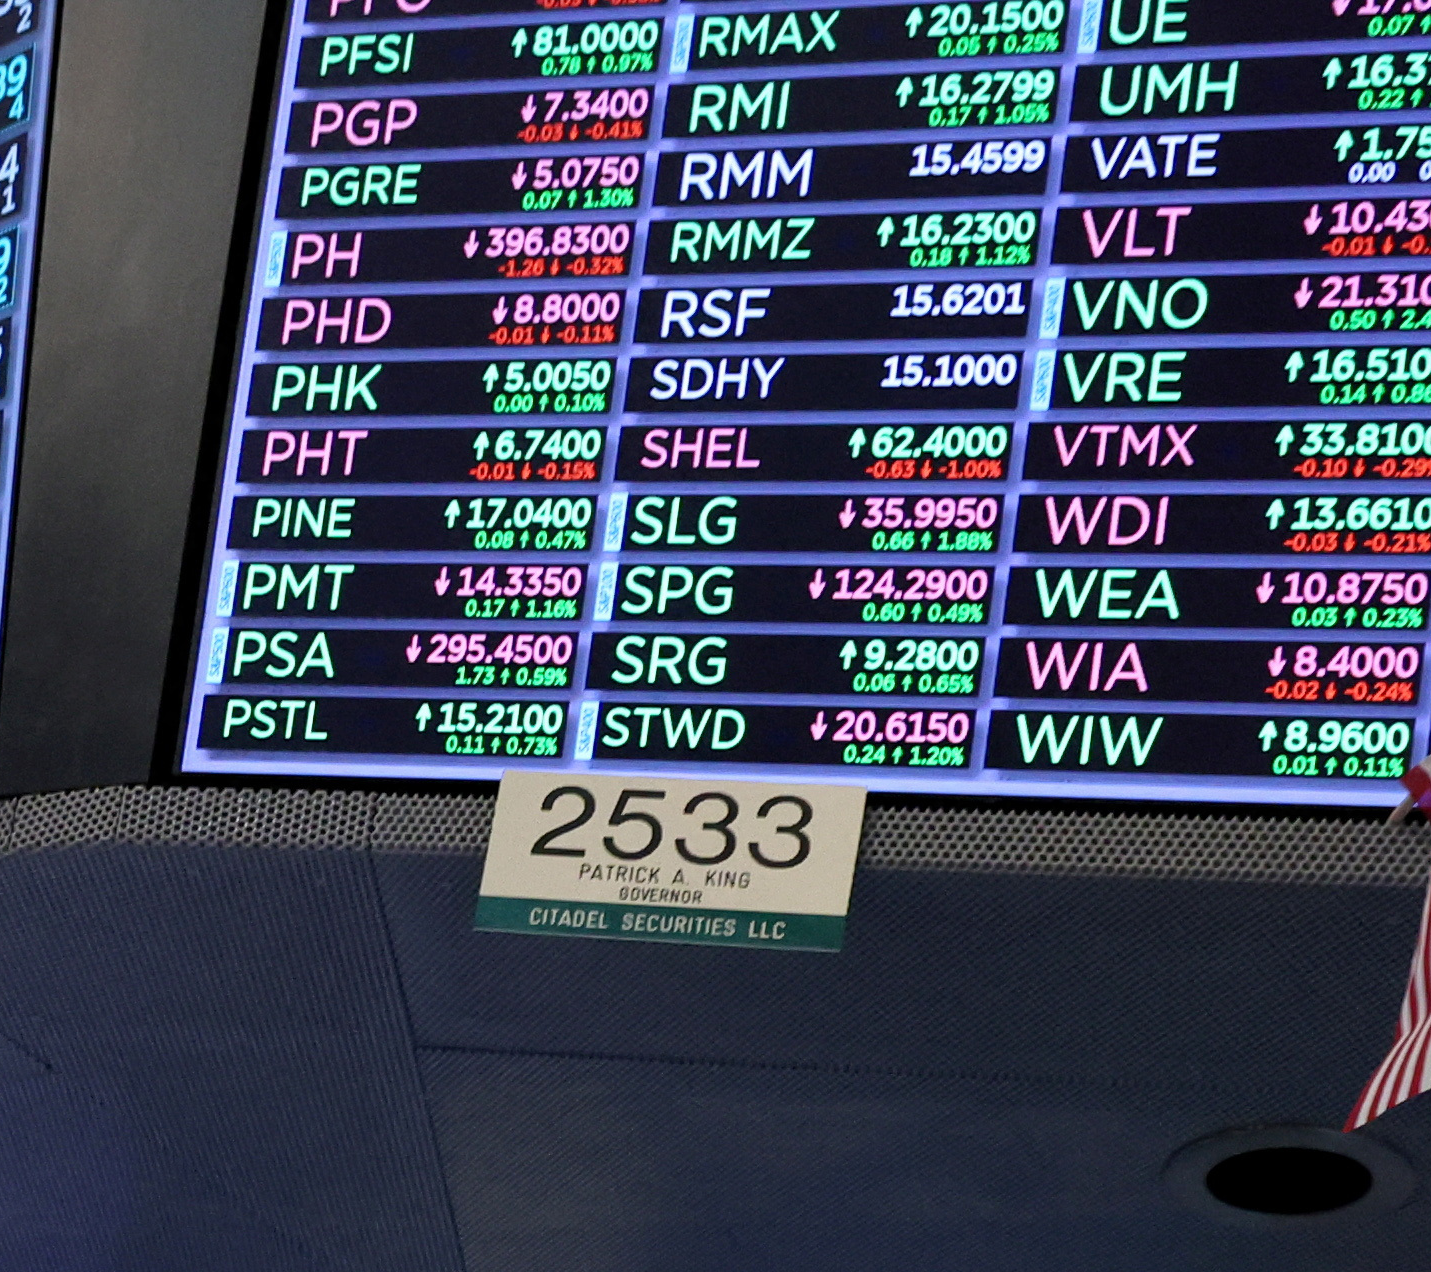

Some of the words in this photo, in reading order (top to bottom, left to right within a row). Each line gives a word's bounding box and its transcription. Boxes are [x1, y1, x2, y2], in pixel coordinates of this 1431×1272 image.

[698, 10, 840, 58] RMAX
[927, 0, 1065, 37] 20.1500
[1109, 0, 1189, 45] UE
[320, 32, 414, 77] PFSI
[532, 20, 659, 57] 81.0000
[689, 80, 791, 133] RMI
[1100, 60, 1239, 116] UMH
[310, 98, 418, 148] PGP
[679, 148, 814, 202] RMM
[1090, 132, 1221, 180] VATE
[300, 163, 422, 208] PGRE
[291, 232, 363, 279] PH
[484, 223, 630, 258] 396.8300
[670, 217, 815, 263] RMMZ
[1082, 206, 1193, 258] VLT
[281, 297, 392, 345] PHD
[513, 292, 621, 324] 8.8000
[660, 287, 772, 338] RSF
[889, 282, 1026, 318] 15.6201
[1072, 278, 1209, 331] VNO
[271, 363, 382, 412] PHK
[649, 356, 786, 400] SDHY
[1063, 351, 1187, 403] VRE
[262, 429, 369, 476] PHT
[494, 428, 602, 461] 6.7400
[640, 427, 761, 469] SHEL
[1053, 424, 1198, 467] VTMX
[469, 462, 516, 481] -0.01
[537, 461, 596, 481] -0.15%
[252, 498, 356, 538] PINE
[630, 496, 738, 545] SLG
[1045, 495, 1170, 546] WDI
[242, 563, 355, 611] PMT
[620, 565, 734, 615] SPG
[832, 568, 989, 601] 124.2900
[1035, 568, 1180, 620] WEA
[233, 630, 335, 678] PSA
[426, 633, 573, 665] 295.4500
[611, 635, 728, 685] SRG
[1026, 641, 1149, 692] WIA
[223, 698, 328, 740] PSTL
[437, 702, 564, 735] 15.2100
[601, 706, 746, 750] STWD
[832, 710, 970, 744] 20.6150
[1016, 713, 1164, 766] WIW
[1283, 719, 1410, 755] 8.9600
[1272, 754, 1319, 776] 0.01
[1343, 756, 1405, 778] 0.11%
[531, 786, 813, 869] 2533
[579, 864, 659, 884] PATRICK
[705, 870, 751, 889] KING
[619, 886, 703, 904] GOVERNOR
[529, 908, 608, 930] CITADEL
[621, 912, 736, 938] SECURITIES
[748, 921, 786, 940] LLC
